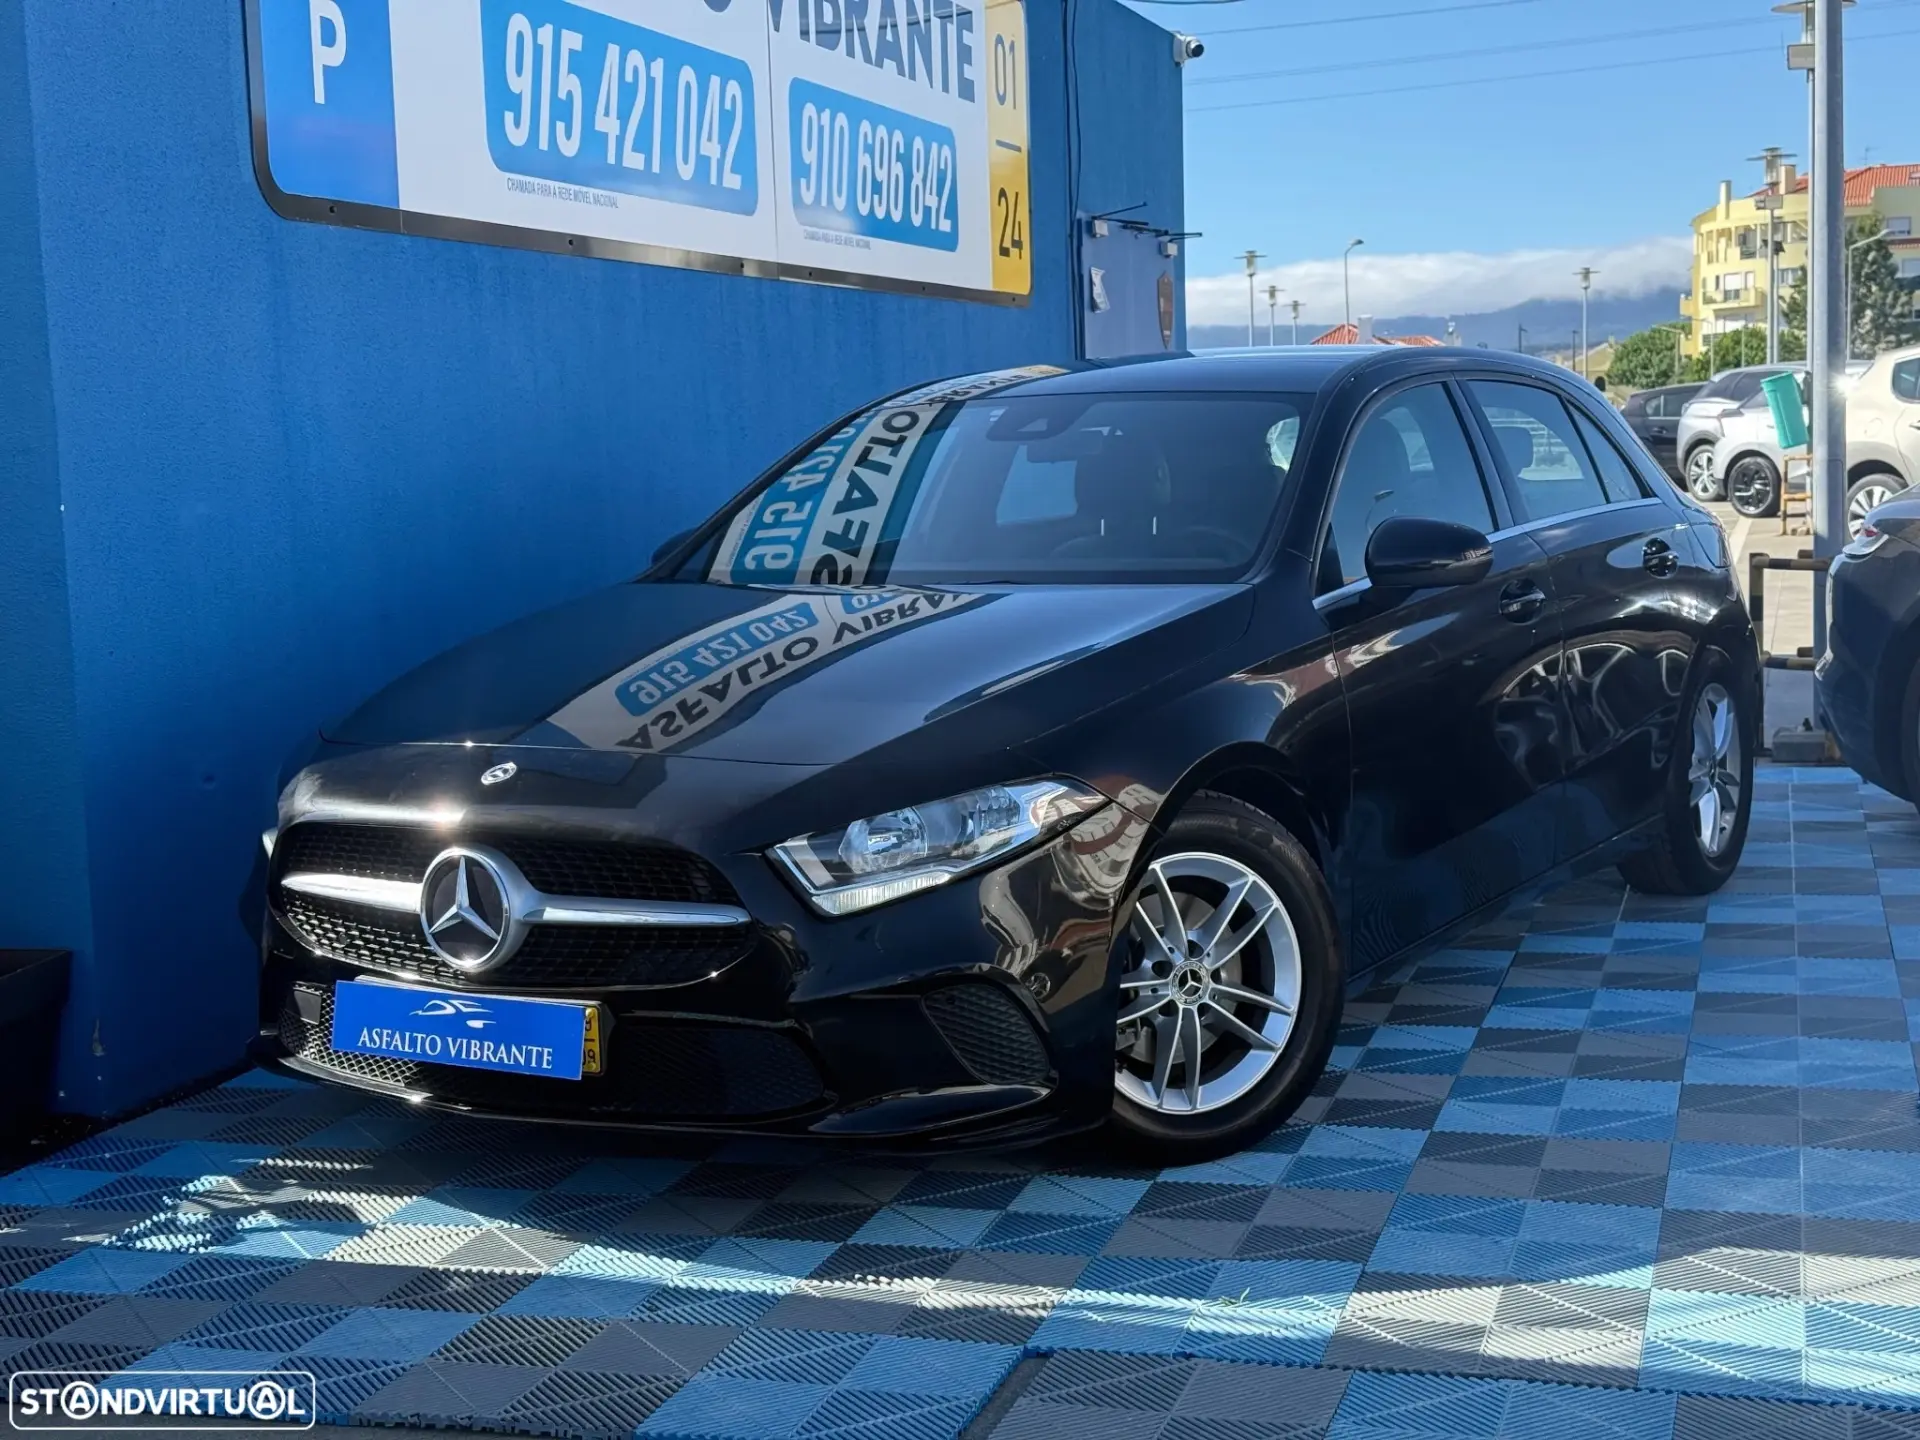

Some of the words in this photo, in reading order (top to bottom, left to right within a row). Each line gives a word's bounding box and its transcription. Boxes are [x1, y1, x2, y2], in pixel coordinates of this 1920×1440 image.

[309, 0, 347, 104] P
[768, 0, 975, 103] RANTE
[995, 33, 1017, 110] 01
[504, 13, 583, 157] 915
[594, 43, 664, 174] 421
[675, 65, 742, 190] 042
[507, 177, 536, 195] CHAMADA
[537, 182, 552, 198] PARA
[558, 186, 573, 201] REDE
[800, 102, 849, 212] 910
[857, 119, 905, 223] 696
[910, 136, 953, 232] 842
[998, 187, 1023, 259] 24
[357, 1026, 442, 1056] ASFALTO
[447, 1036, 553, 1069] VIBRANTE
